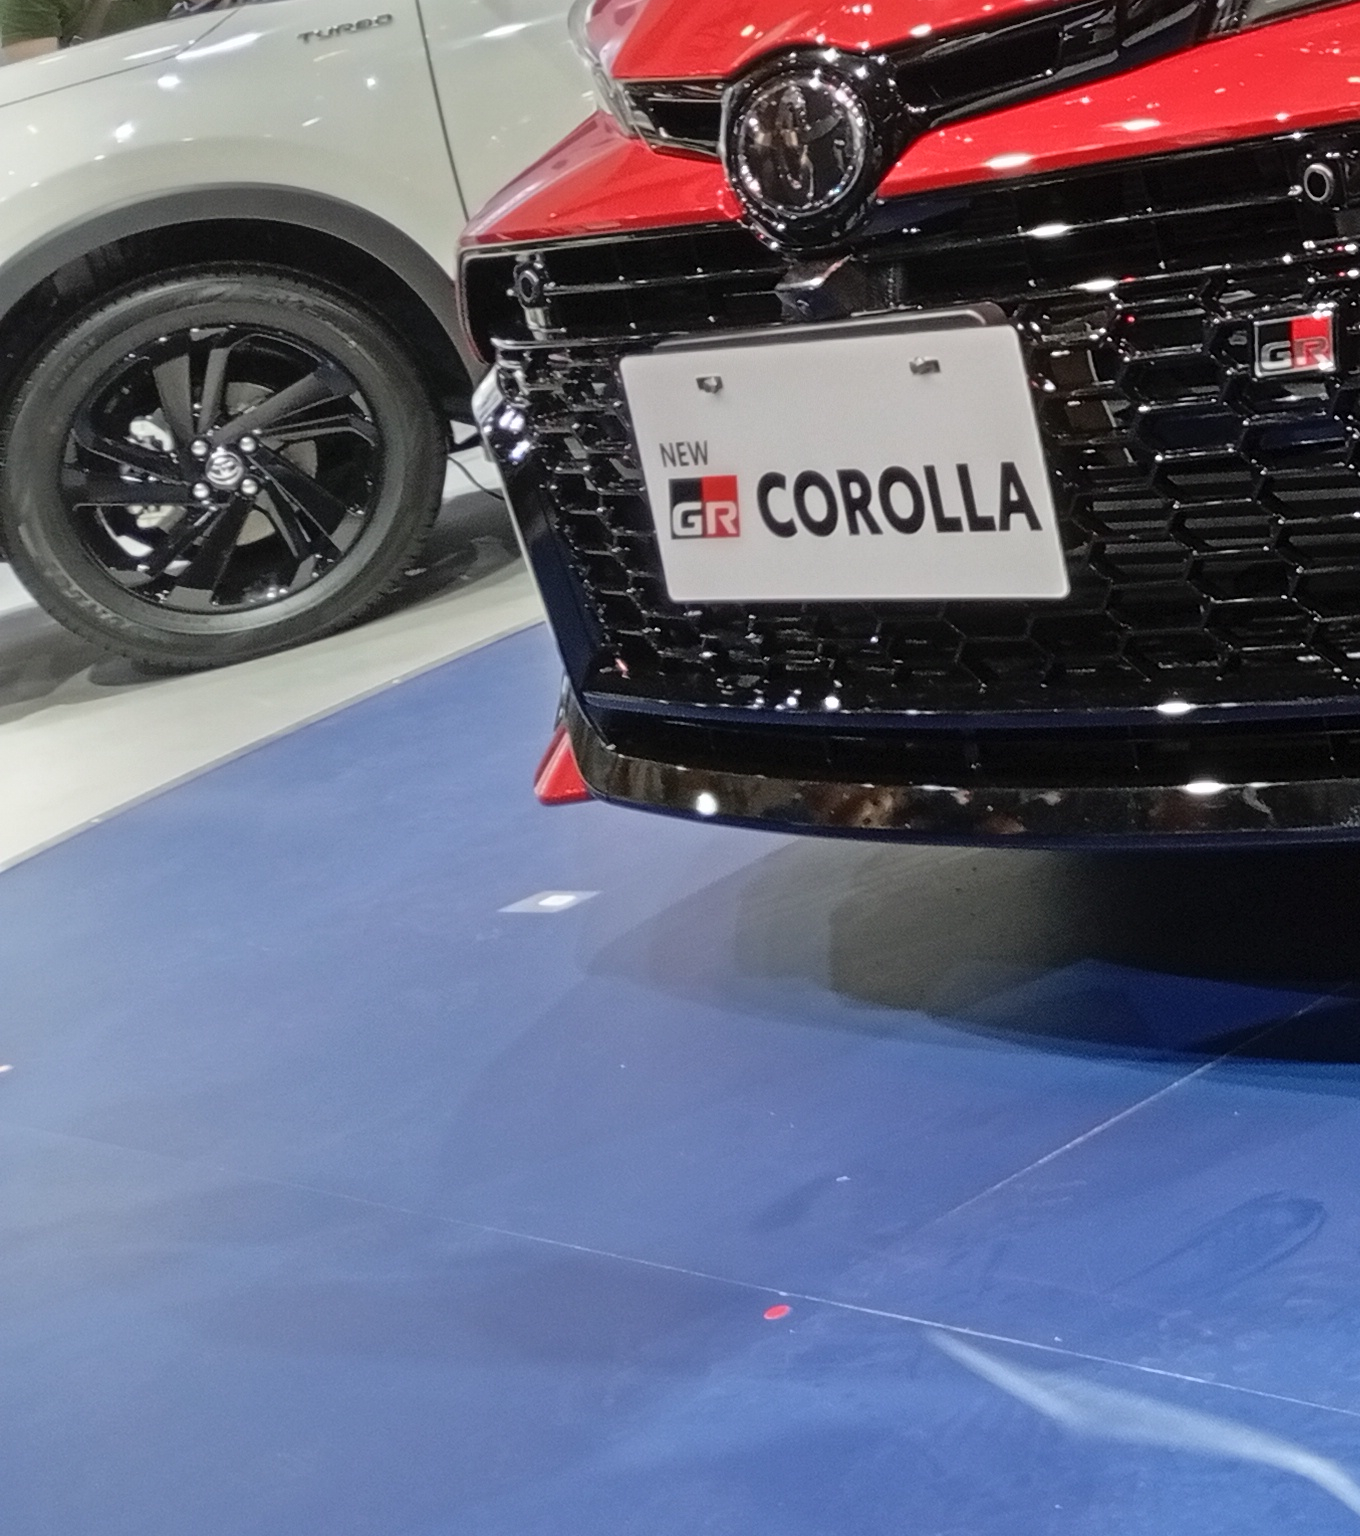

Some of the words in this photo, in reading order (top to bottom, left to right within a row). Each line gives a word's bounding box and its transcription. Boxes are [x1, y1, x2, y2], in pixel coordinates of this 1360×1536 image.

[297, 13, 393, 44] TURBO
[1260, 332, 1335, 370] GR
[659, 440, 709, 469] NEW
[670, 496, 740, 540] GR
[756, 461, 1044, 540] COROLLA
